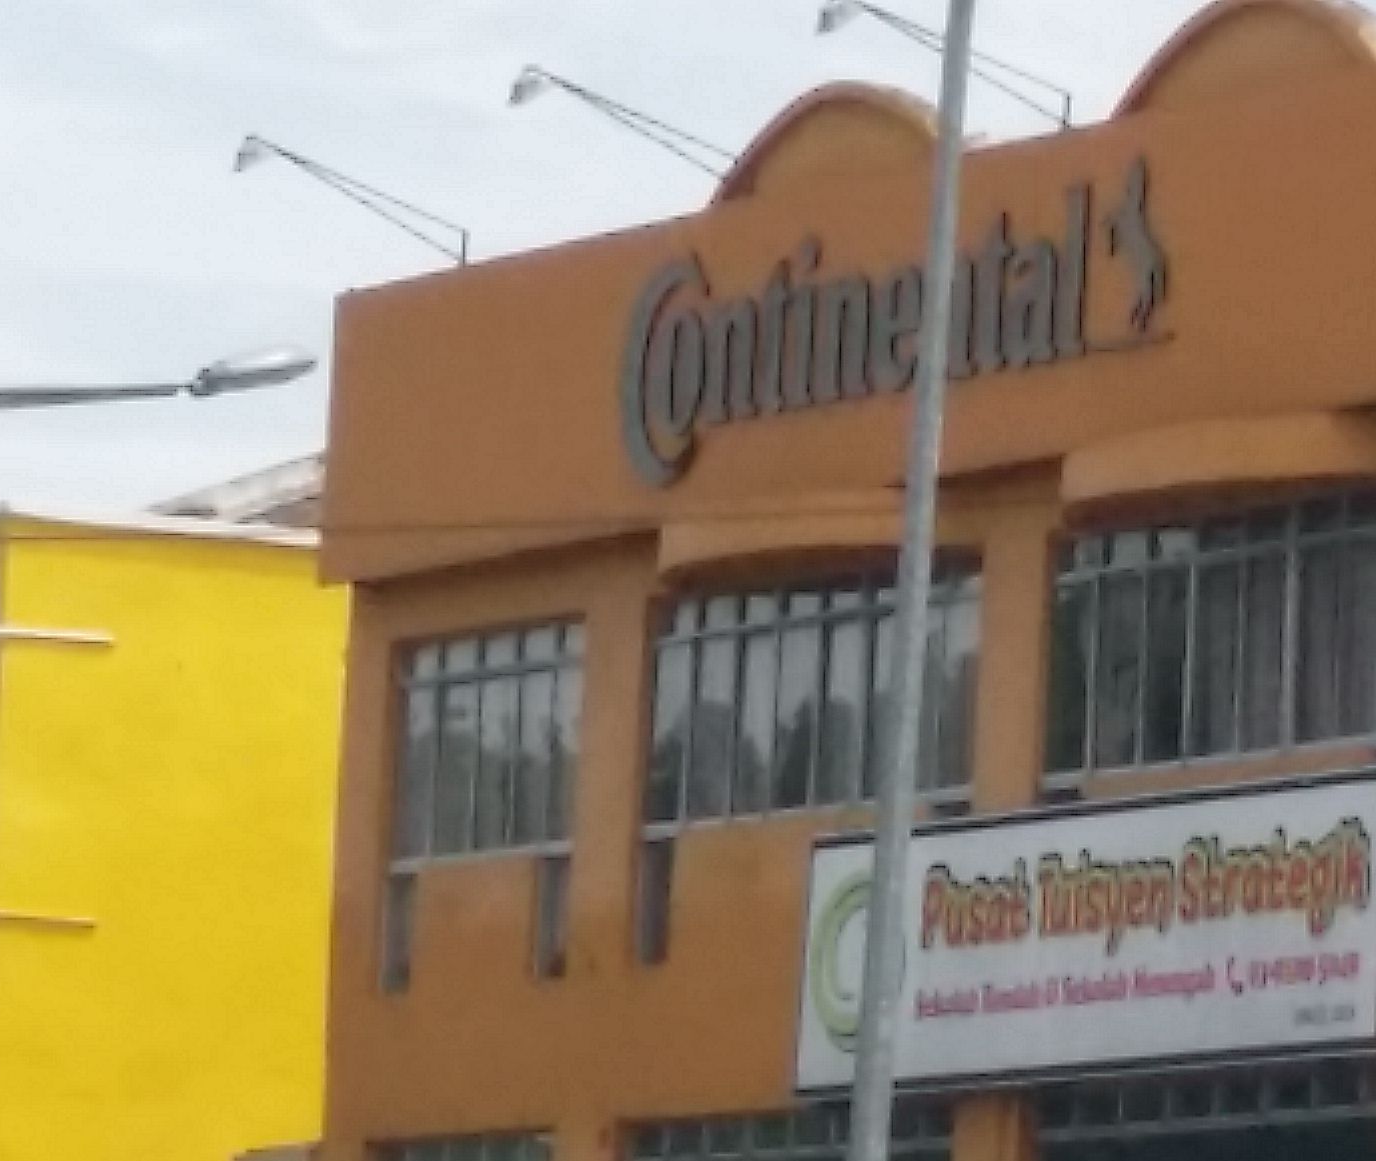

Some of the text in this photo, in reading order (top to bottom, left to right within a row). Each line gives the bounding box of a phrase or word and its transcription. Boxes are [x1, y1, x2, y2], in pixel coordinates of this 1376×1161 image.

[619, 181, 1090, 488] Continental
[920, 858, 1030, 950] Pusat
[1178, 816, 1371, 939] Strategik
